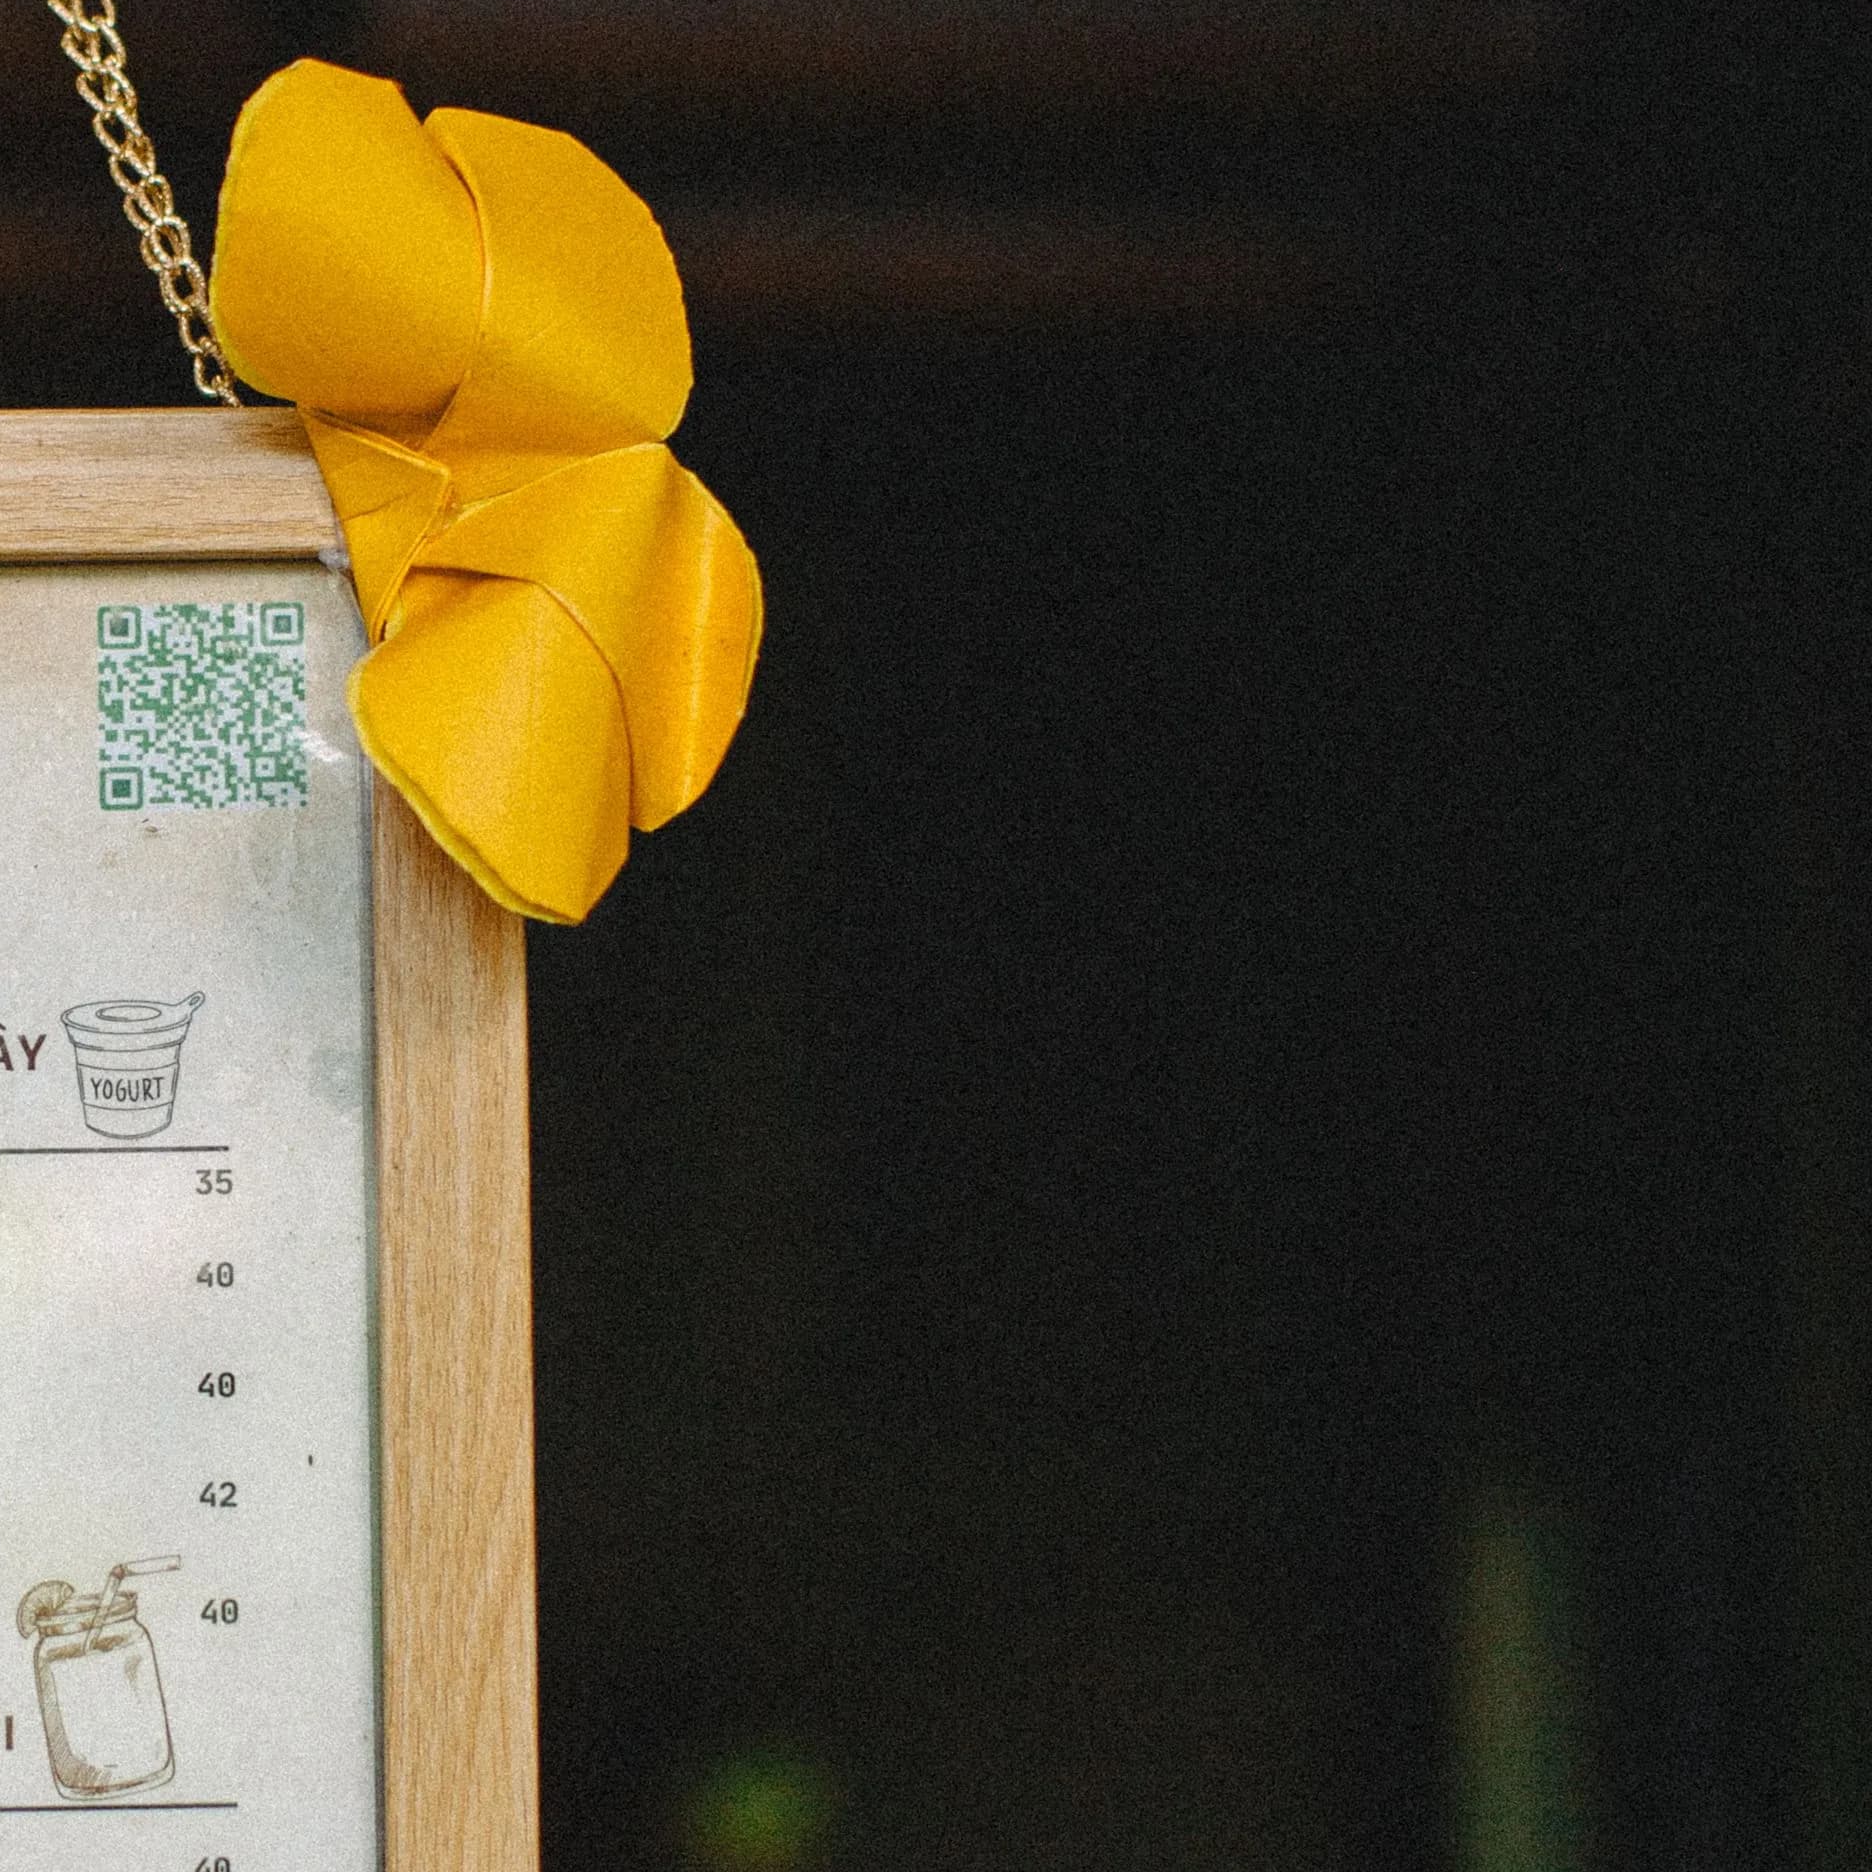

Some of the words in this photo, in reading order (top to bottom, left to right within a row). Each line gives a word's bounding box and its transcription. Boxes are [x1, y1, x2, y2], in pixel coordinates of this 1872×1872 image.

[89, 1075, 165, 1104] YOGURT
[195, 1168, 234, 1196] 35
[198, 1480, 238, 1509] 42
